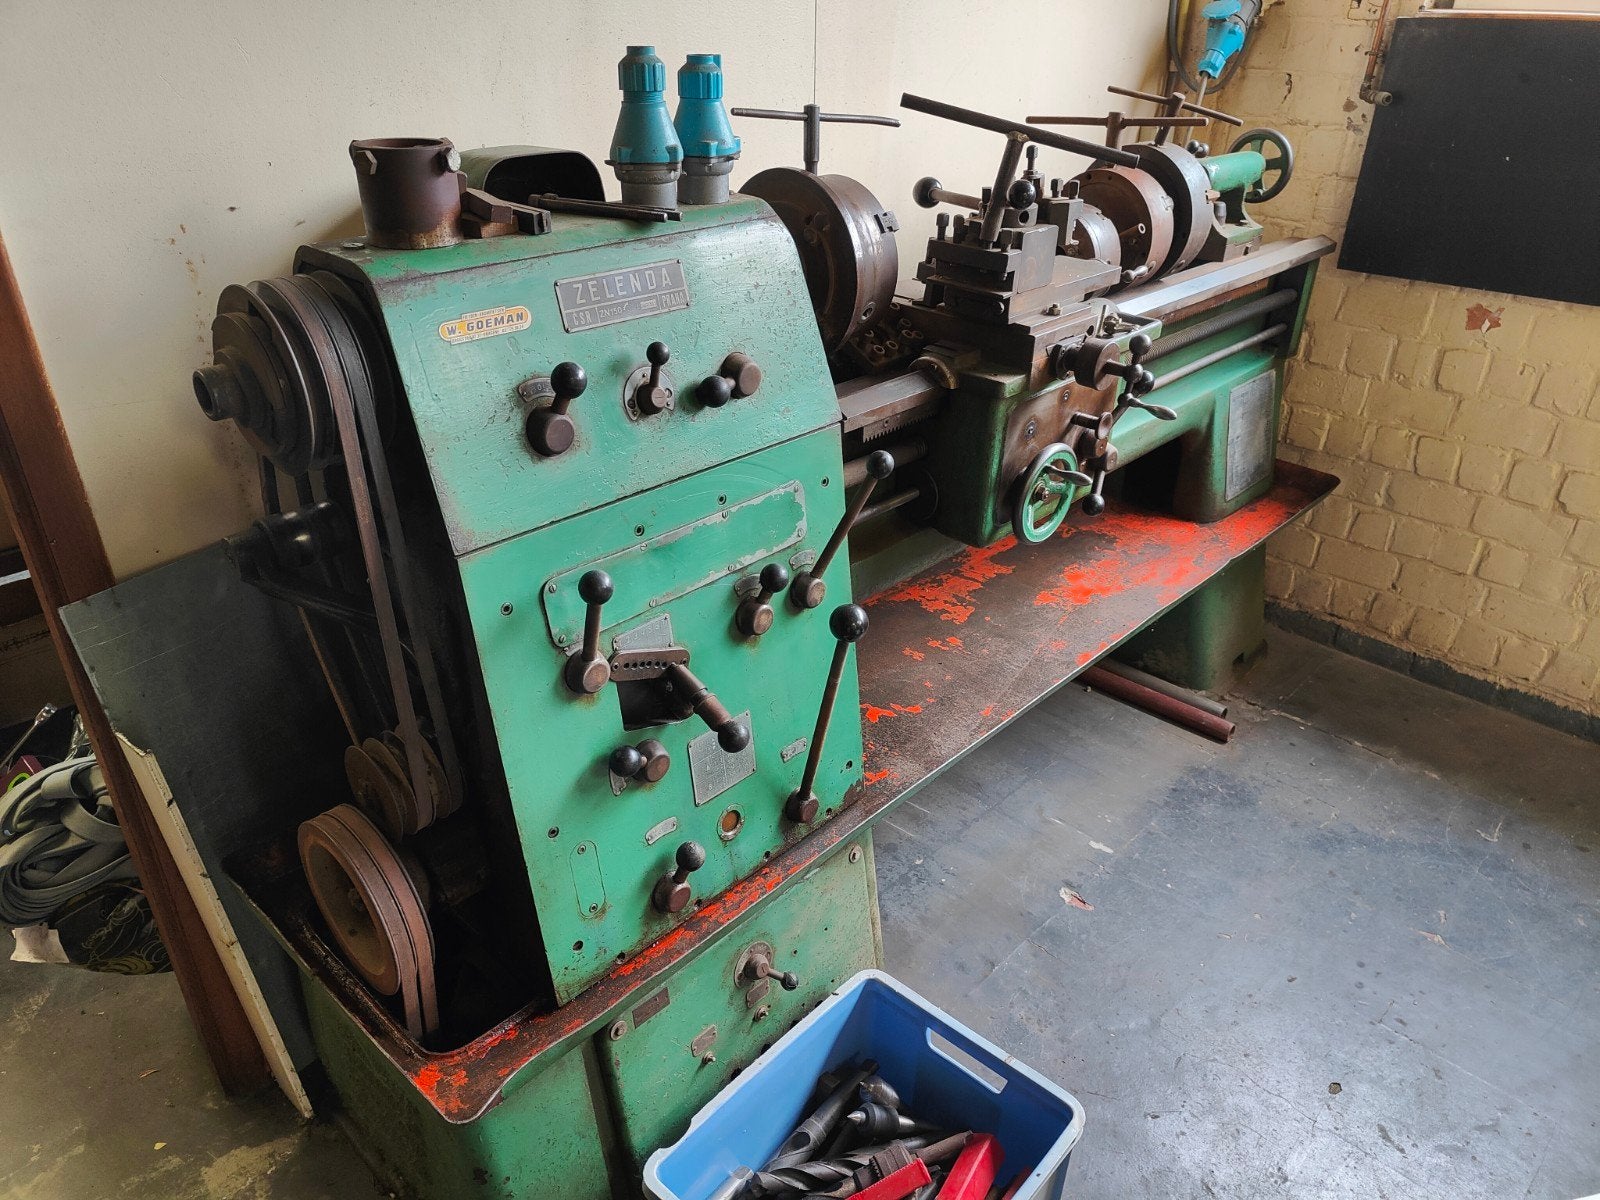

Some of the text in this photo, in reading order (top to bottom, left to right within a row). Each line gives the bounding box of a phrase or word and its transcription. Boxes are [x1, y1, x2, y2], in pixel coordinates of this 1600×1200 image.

[573, 267, 672, 305] ZELENDA
[446, 325, 462, 336] W.
[467, 312, 524, 332] GOEMAN
